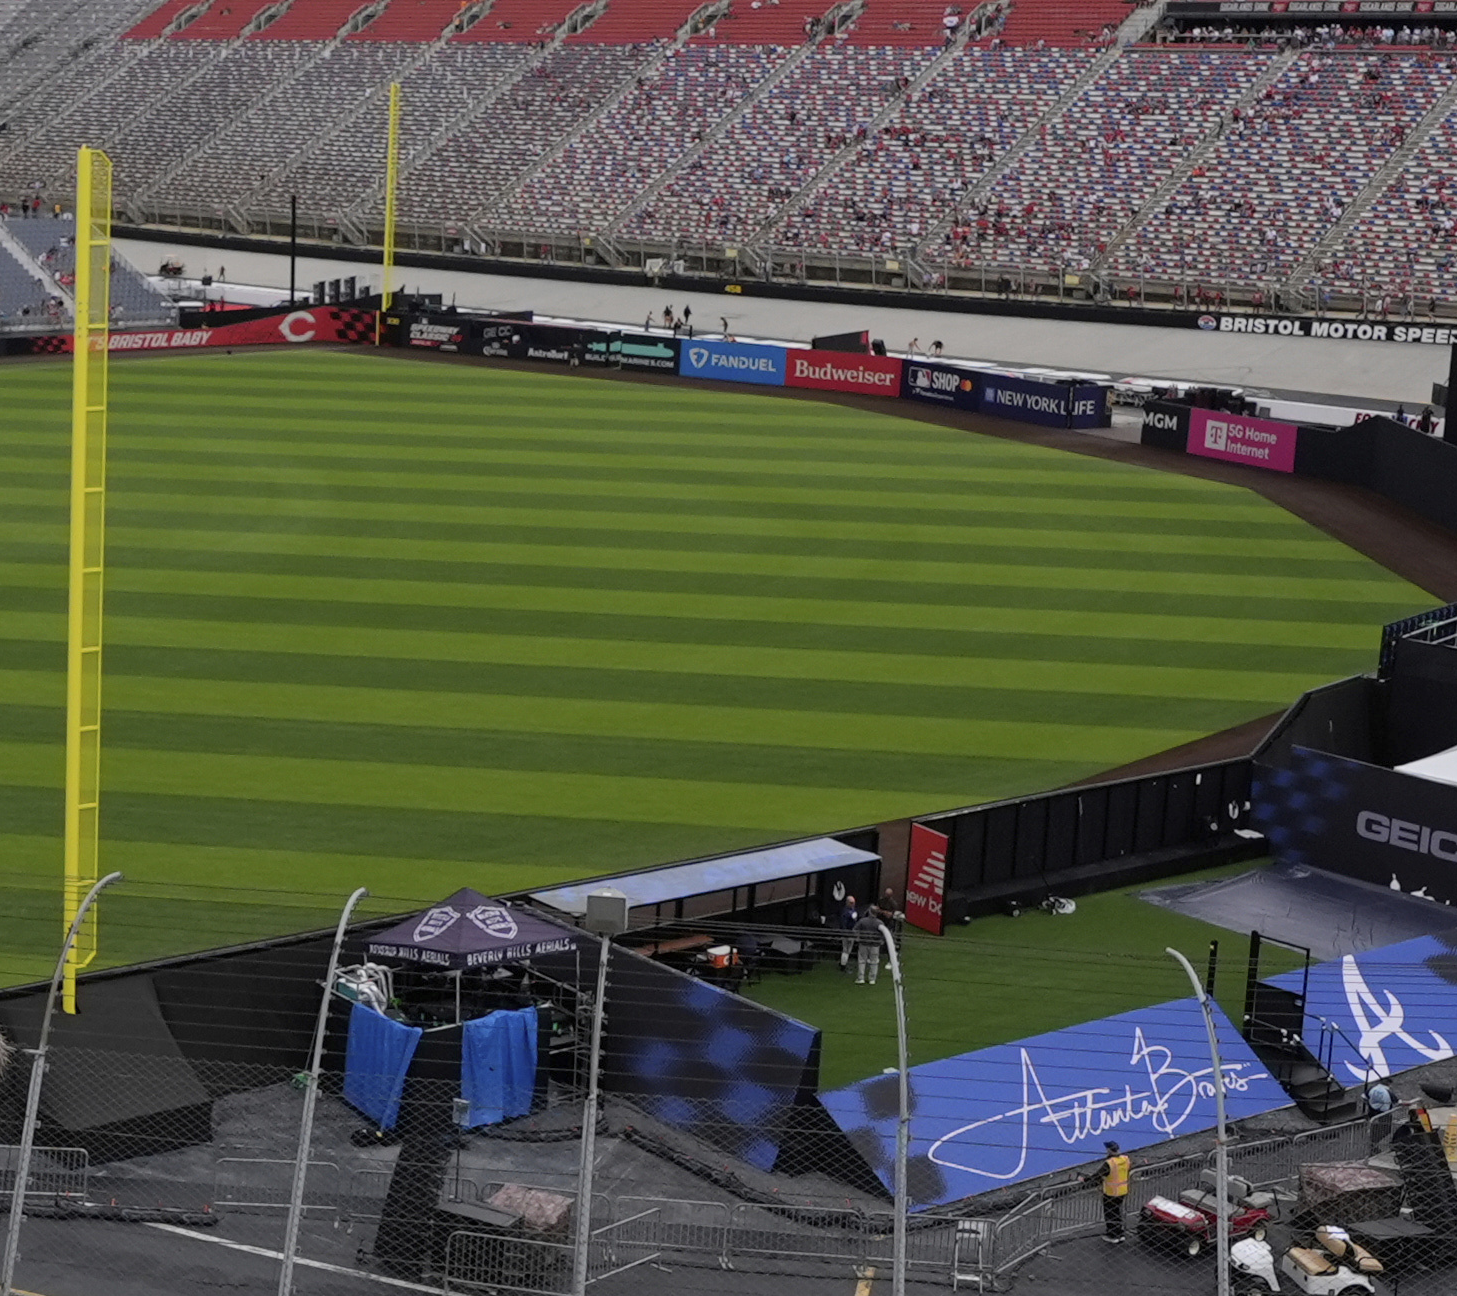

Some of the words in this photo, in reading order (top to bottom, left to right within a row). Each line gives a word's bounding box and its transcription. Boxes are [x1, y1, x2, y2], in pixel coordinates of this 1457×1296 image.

[410, 323, 460, 335] SPEEDWAY
[1220, 317, 1305, 336] BRISTOL
[1311, 322, 1388, 341] MOTOR
[108, 333, 171, 350] BRISTOL
[173, 330, 213, 346] BABY
[527, 347, 569, 360] AstroTurf
[711, 354, 776, 373] FANDUEL
[794, 358, 896, 386] Budweiser
[932, 371, 960, 393] SHOP
[996, 389, 1025, 406] NEW
[1025, 394, 1060, 413] YORK
[1060, 400, 1096, 416] LIFE
[1142, 411, 1178, 430] MGM
[1228, 423, 1244, 439] 5G
[1246, 425, 1277, 445] Home
[1226, 440, 1270, 460] Internet
[466, 952, 502, 966] BEVERLY
[506, 944, 531, 959] HILLS
[536, 938, 569, 953] AERIALS
